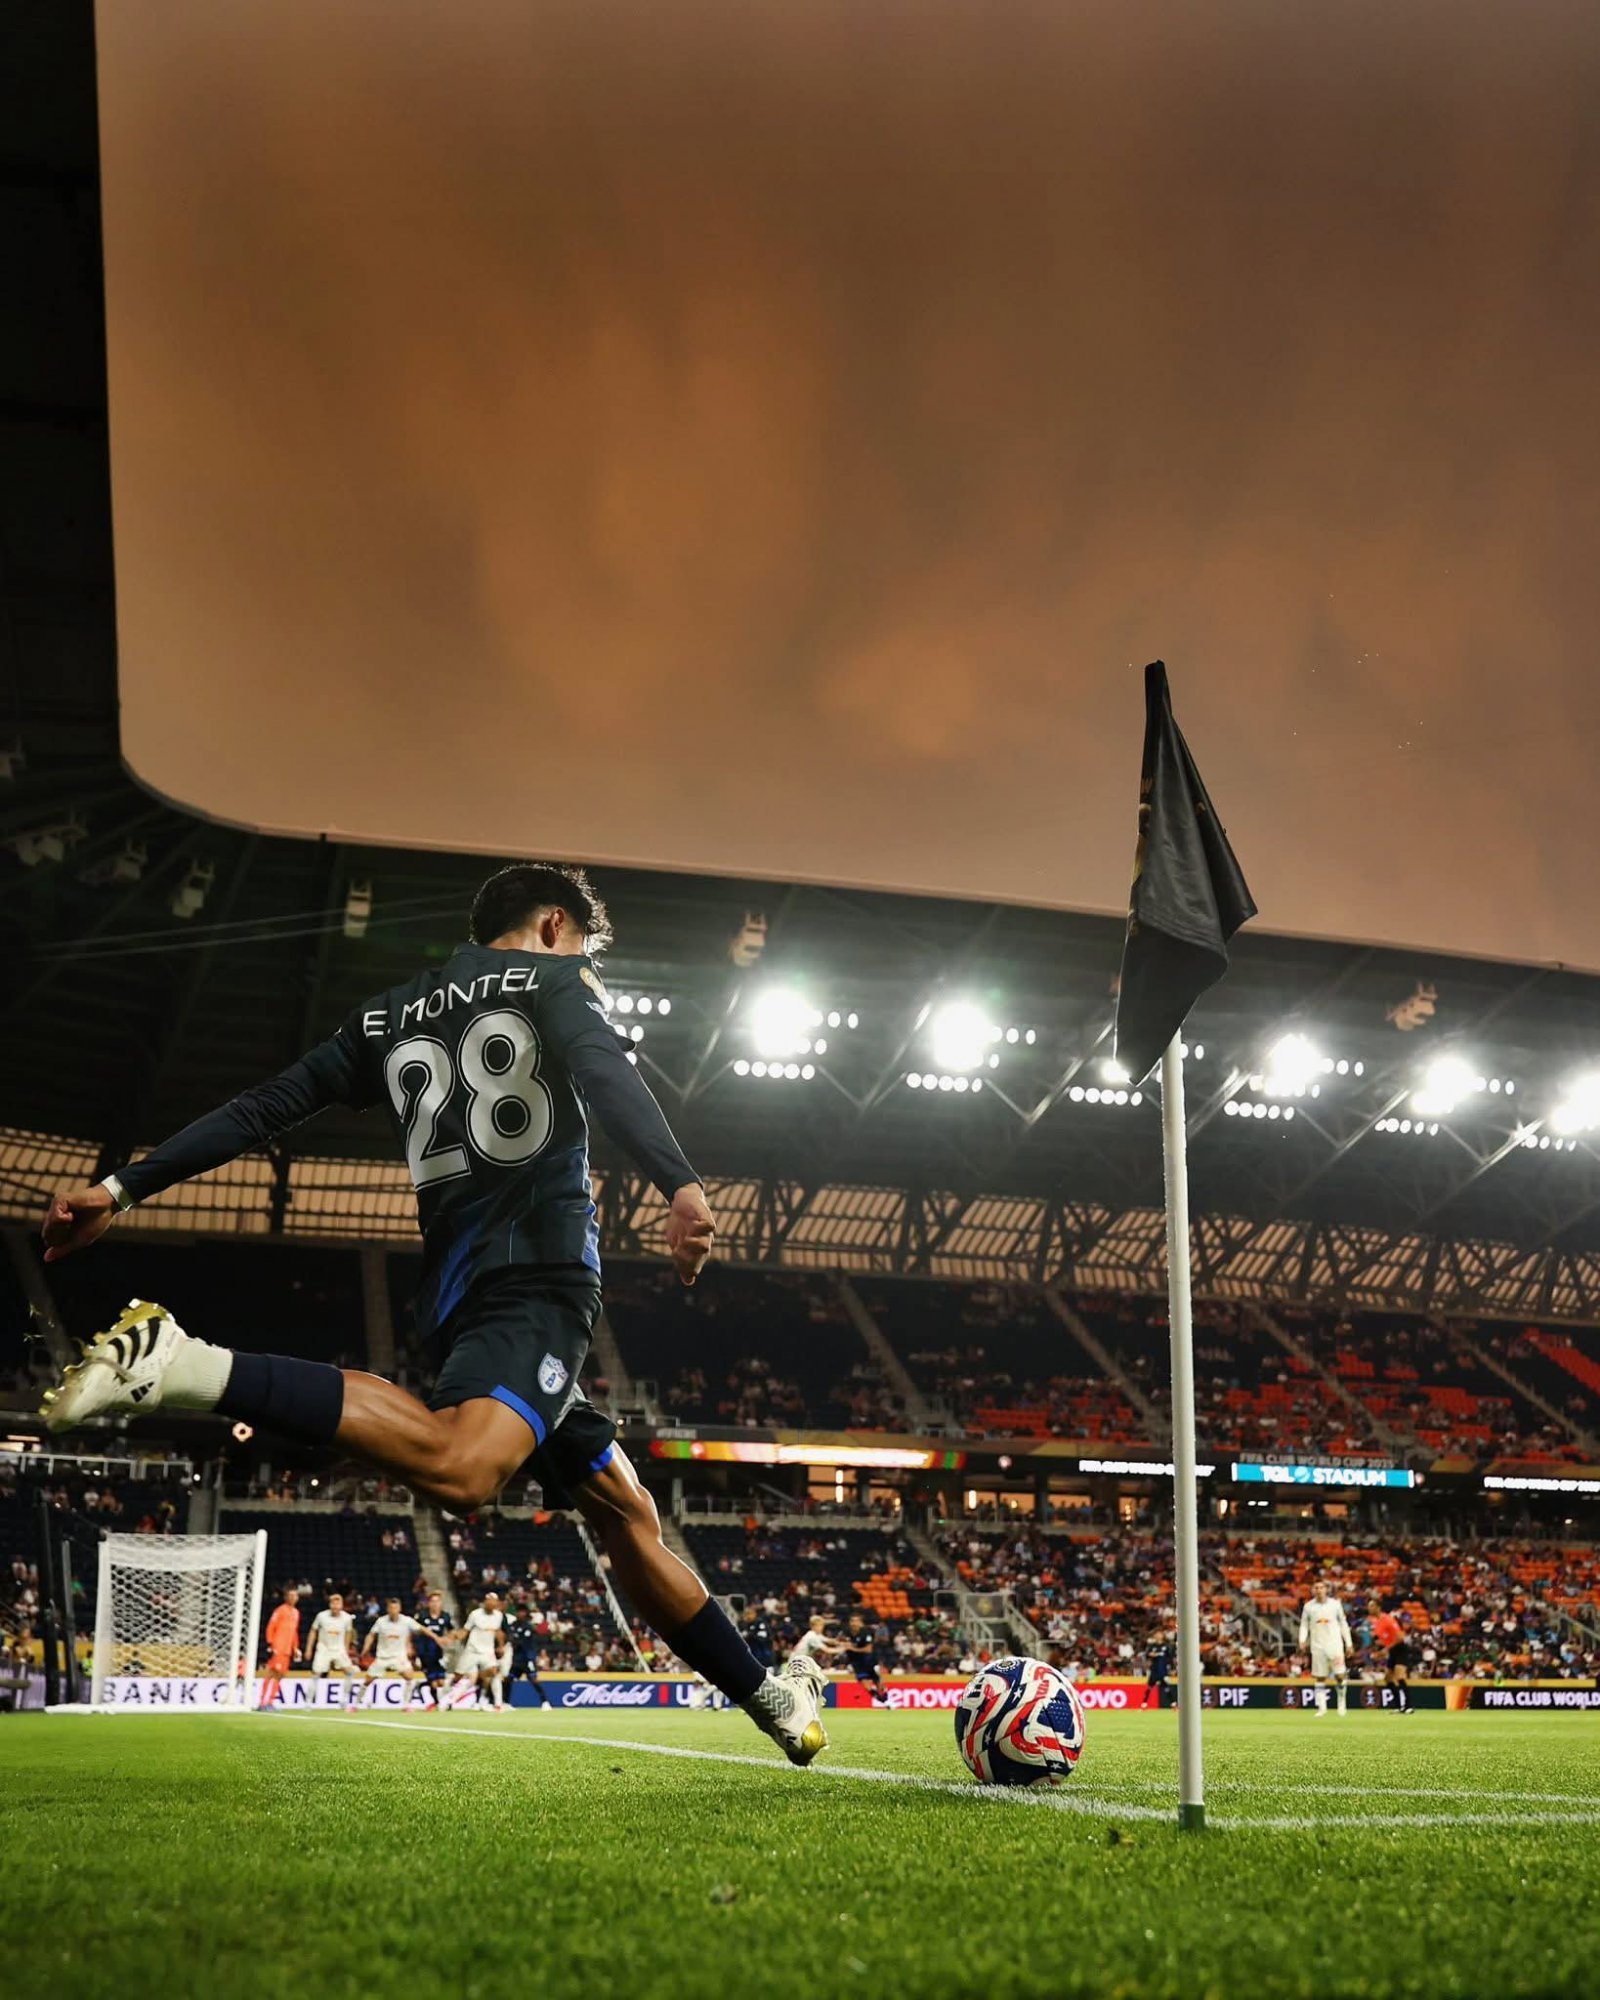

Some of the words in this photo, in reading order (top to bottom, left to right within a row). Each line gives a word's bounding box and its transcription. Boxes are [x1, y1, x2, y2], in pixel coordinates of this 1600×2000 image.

[363, 1010, 391, 1038] E.
[400, 966, 539, 1029] MONTEL
[384, 1008, 555, 1192] 28
[1312, 1467, 1387, 1486] STADIUM
[102, 1682, 198, 1704] BANK
[562, 1683, 654, 1707] Michelob
[1219, 1688, 1250, 1707] PIF
[1484, 1691, 1515, 1706] FIFA
[1516, 1691, 1551, 1706] CLUB
[1553, 1691, 1600, 1706] WORLD
